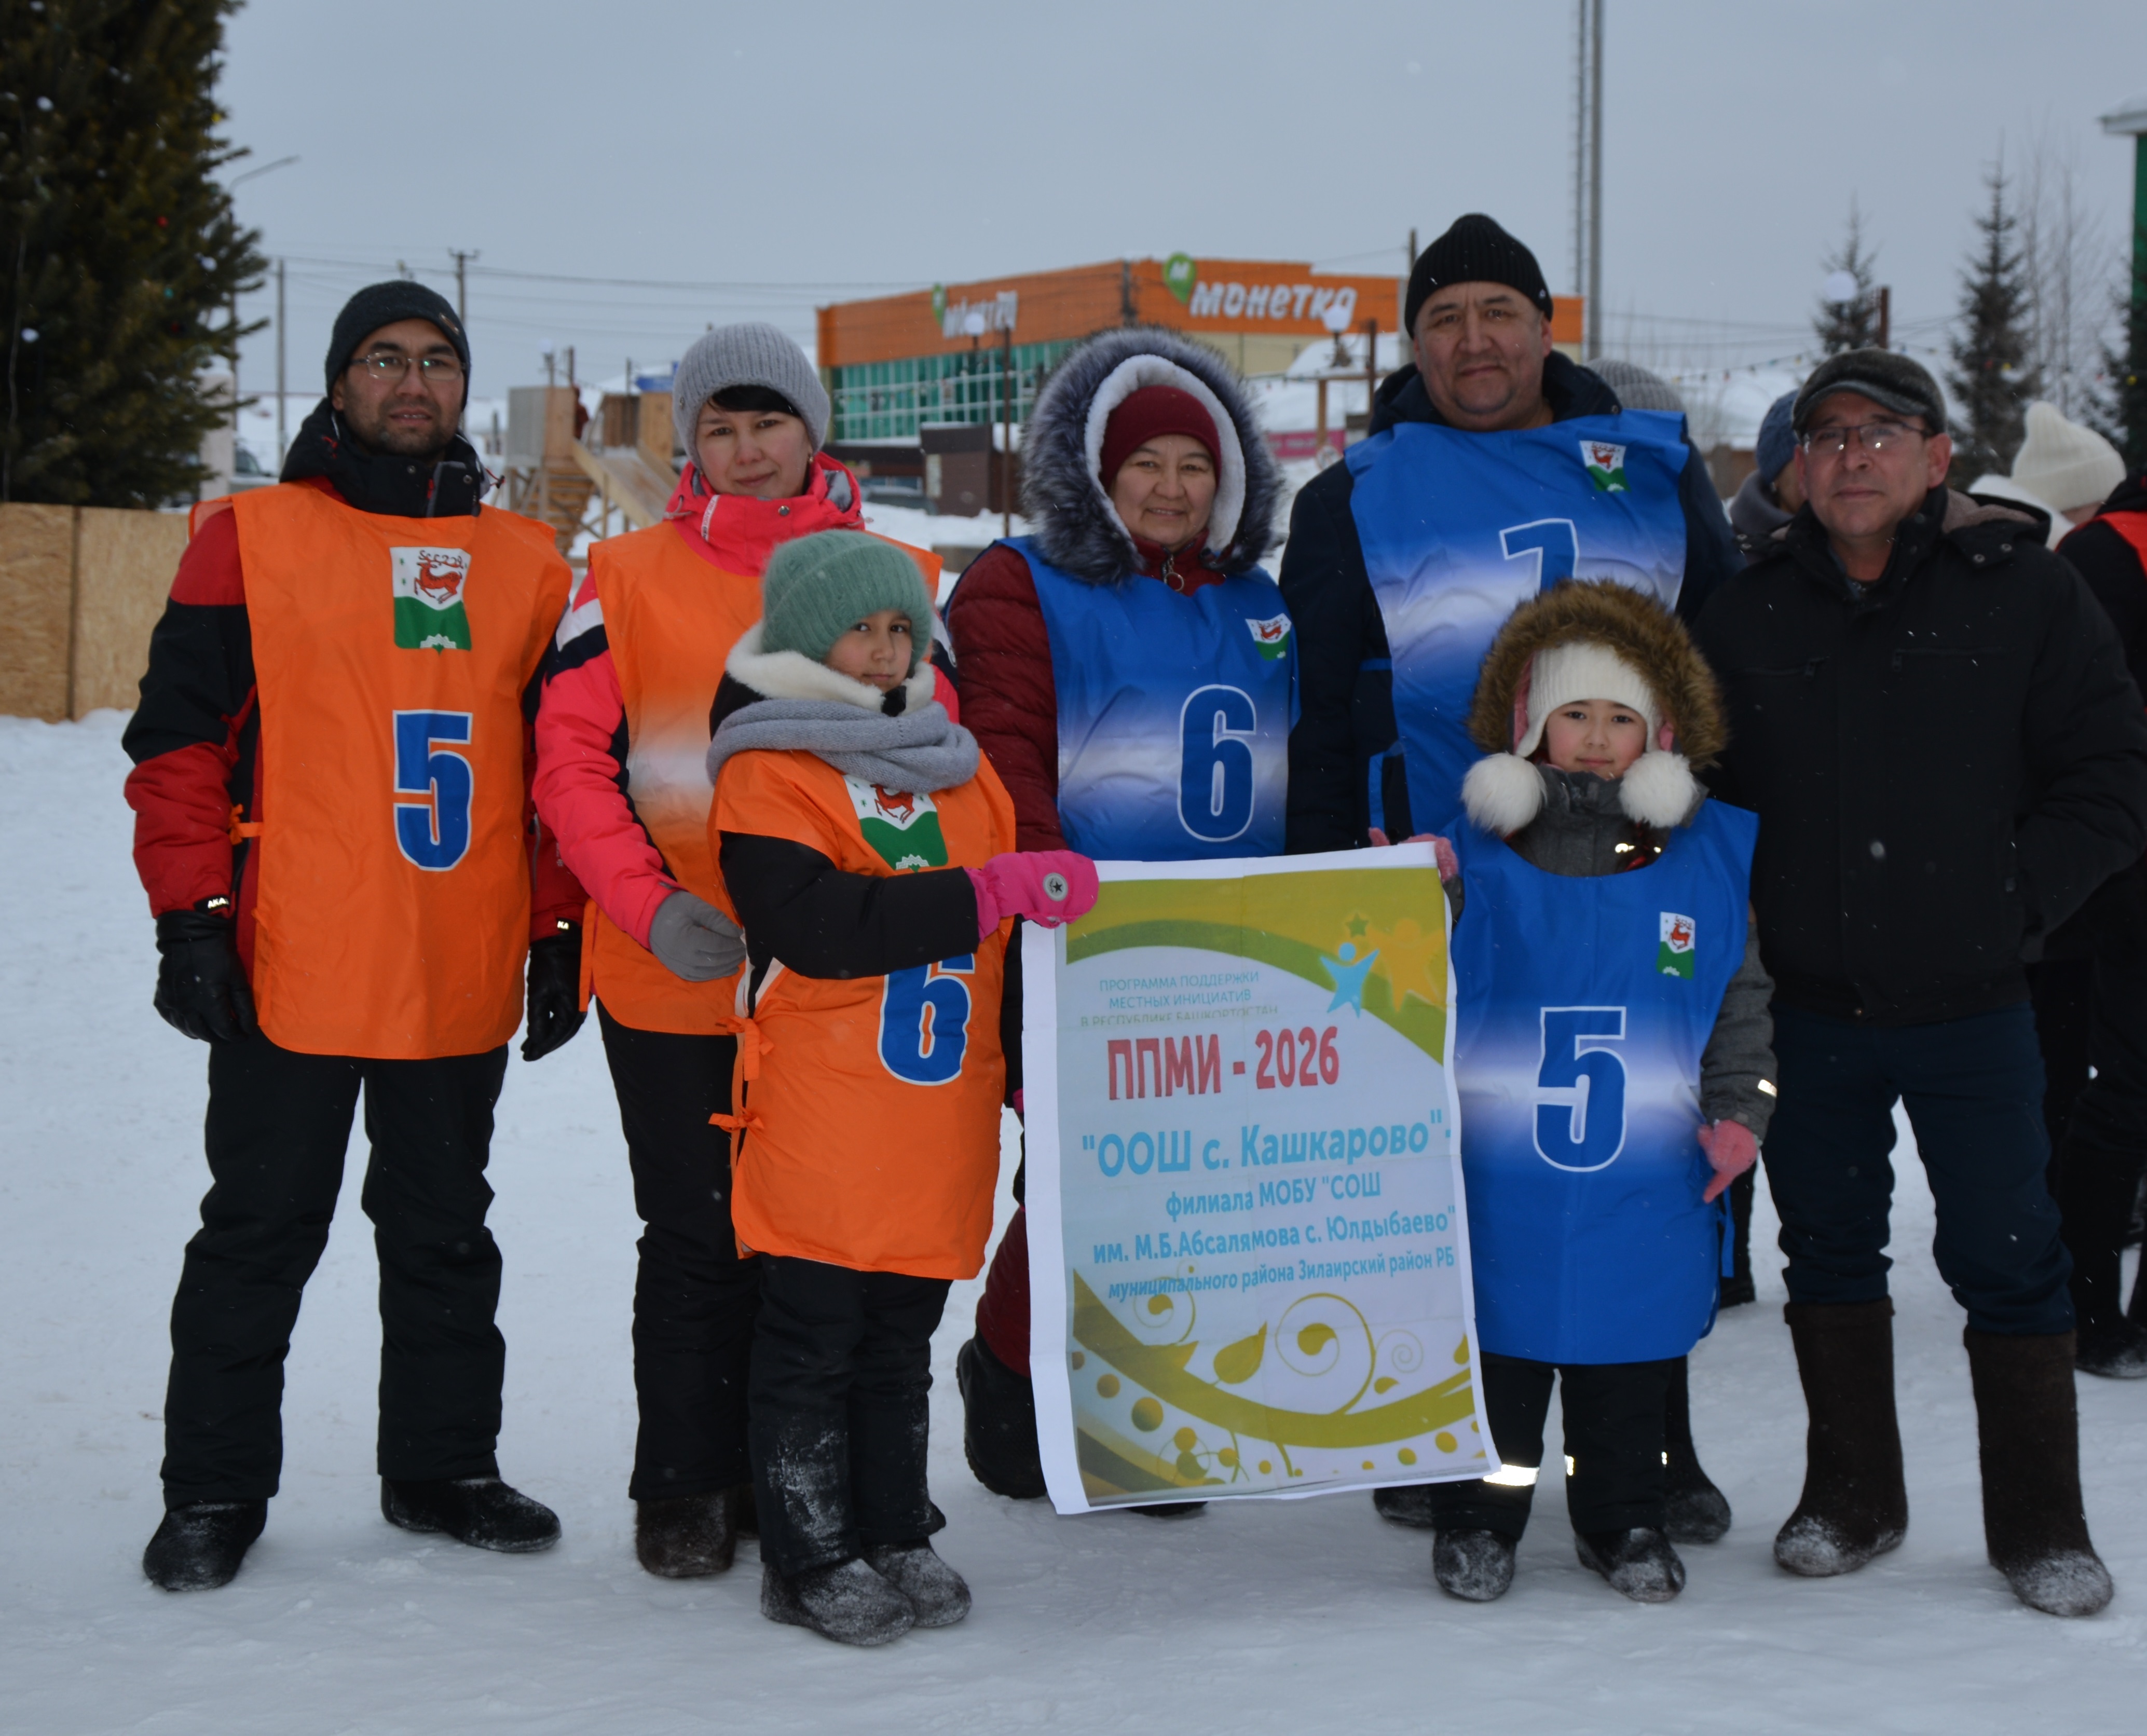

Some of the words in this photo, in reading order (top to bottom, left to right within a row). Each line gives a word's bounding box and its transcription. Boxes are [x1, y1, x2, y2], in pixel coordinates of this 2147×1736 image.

[392, 709, 473, 872] 5
[1177, 684, 1256, 842] 6
[1099, 977, 1177, 992] ПРОГРАММА
[1180, 971, 1259, 988] ПОДДЕРЖКИ
[1109, 996, 1170, 1009] МЕСТНЫХ
[1173, 988, 1251, 1006] ИНИЦИАТИВ
[878, 953, 975, 1086] 6
[1107, 1033, 1221, 1100] ППМИ
[1255, 1026, 1339, 1090] 2026
[1533, 1006, 1626, 1173] 5
[1083, 1130, 1191, 1177] "ООШ
[1202, 1139, 1229, 1170] с.
[1241, 1109, 1442, 1167] Кашкарово"
[1166, 1191, 1253, 1222] филиала
[1259, 1177, 1317, 1207] МОБУ
[1322, 1171, 1381, 1199] "СОШ
[1093, 1243, 1129, 1264] им.
[1135, 1226, 1300, 1260] М.Б.Абсалямова
[1305, 1225, 1322, 1243] с.
[1327, 1205, 1455, 1242] Юлдыбаево"
[1109, 1273, 1238, 1303] муниципального
[1242, 1264, 1294, 1292] района
[1299, 1252, 1386, 1281] Зилаирский
[1389, 1250, 1432, 1277] район
[1436, 1246, 1455, 1267] РБ
